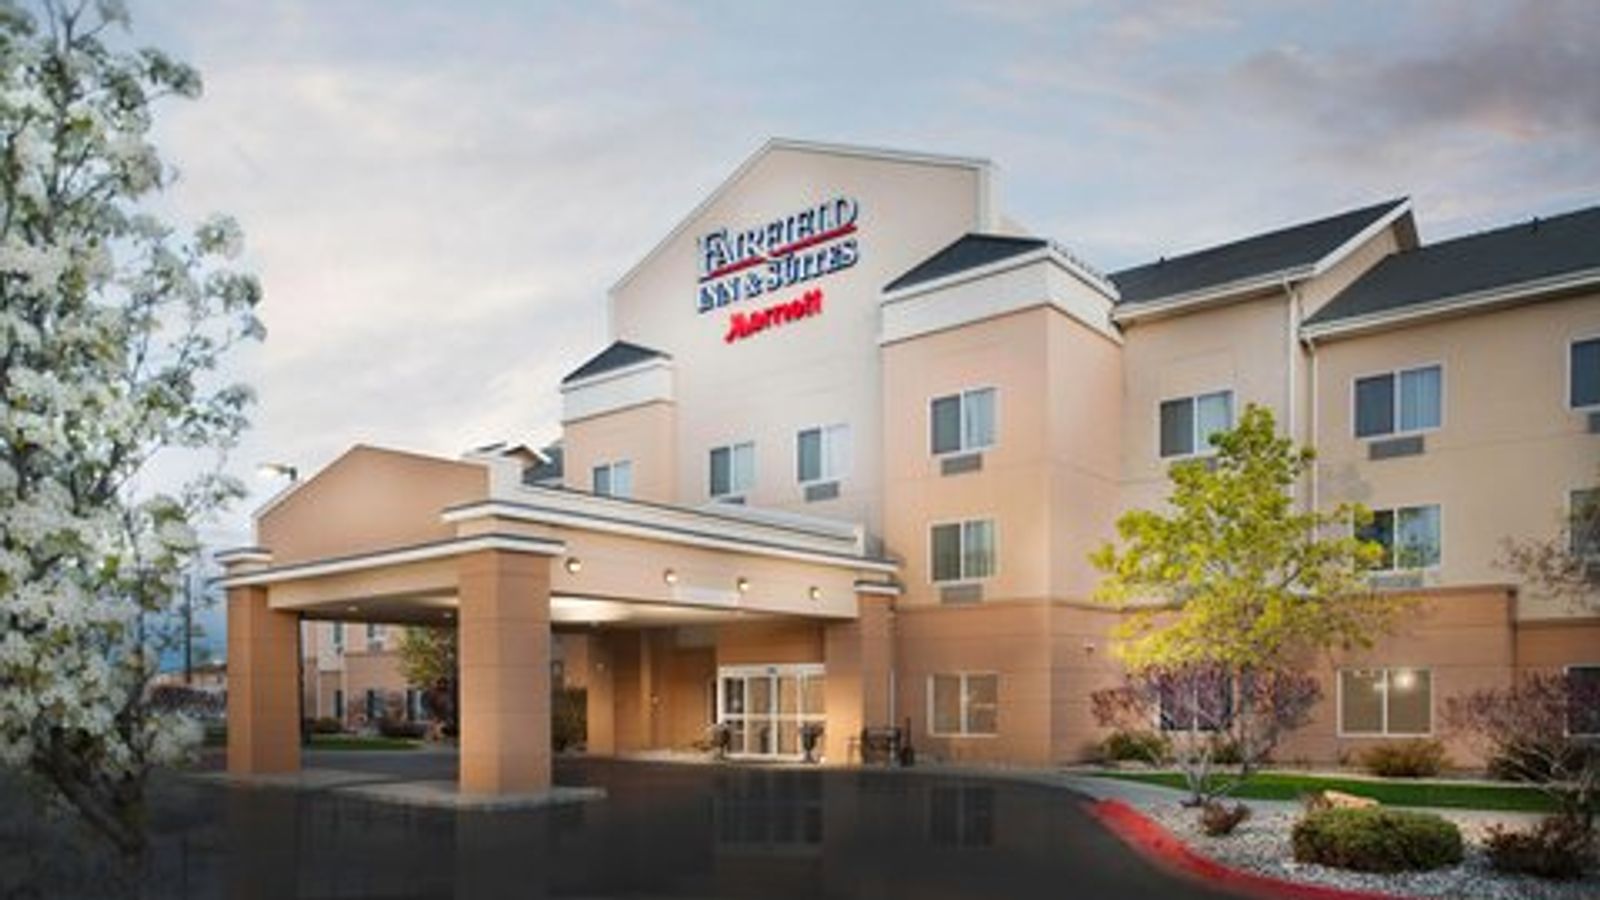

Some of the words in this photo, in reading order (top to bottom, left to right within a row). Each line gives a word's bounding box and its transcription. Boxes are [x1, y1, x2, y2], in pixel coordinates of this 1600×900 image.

[696, 197, 858, 276] FAIRFIELD
[697, 278, 741, 314] INN
[744, 273, 763, 298] &
[766, 239, 859, 292] SUITES
[725, 288, 823, 343] Marriott
